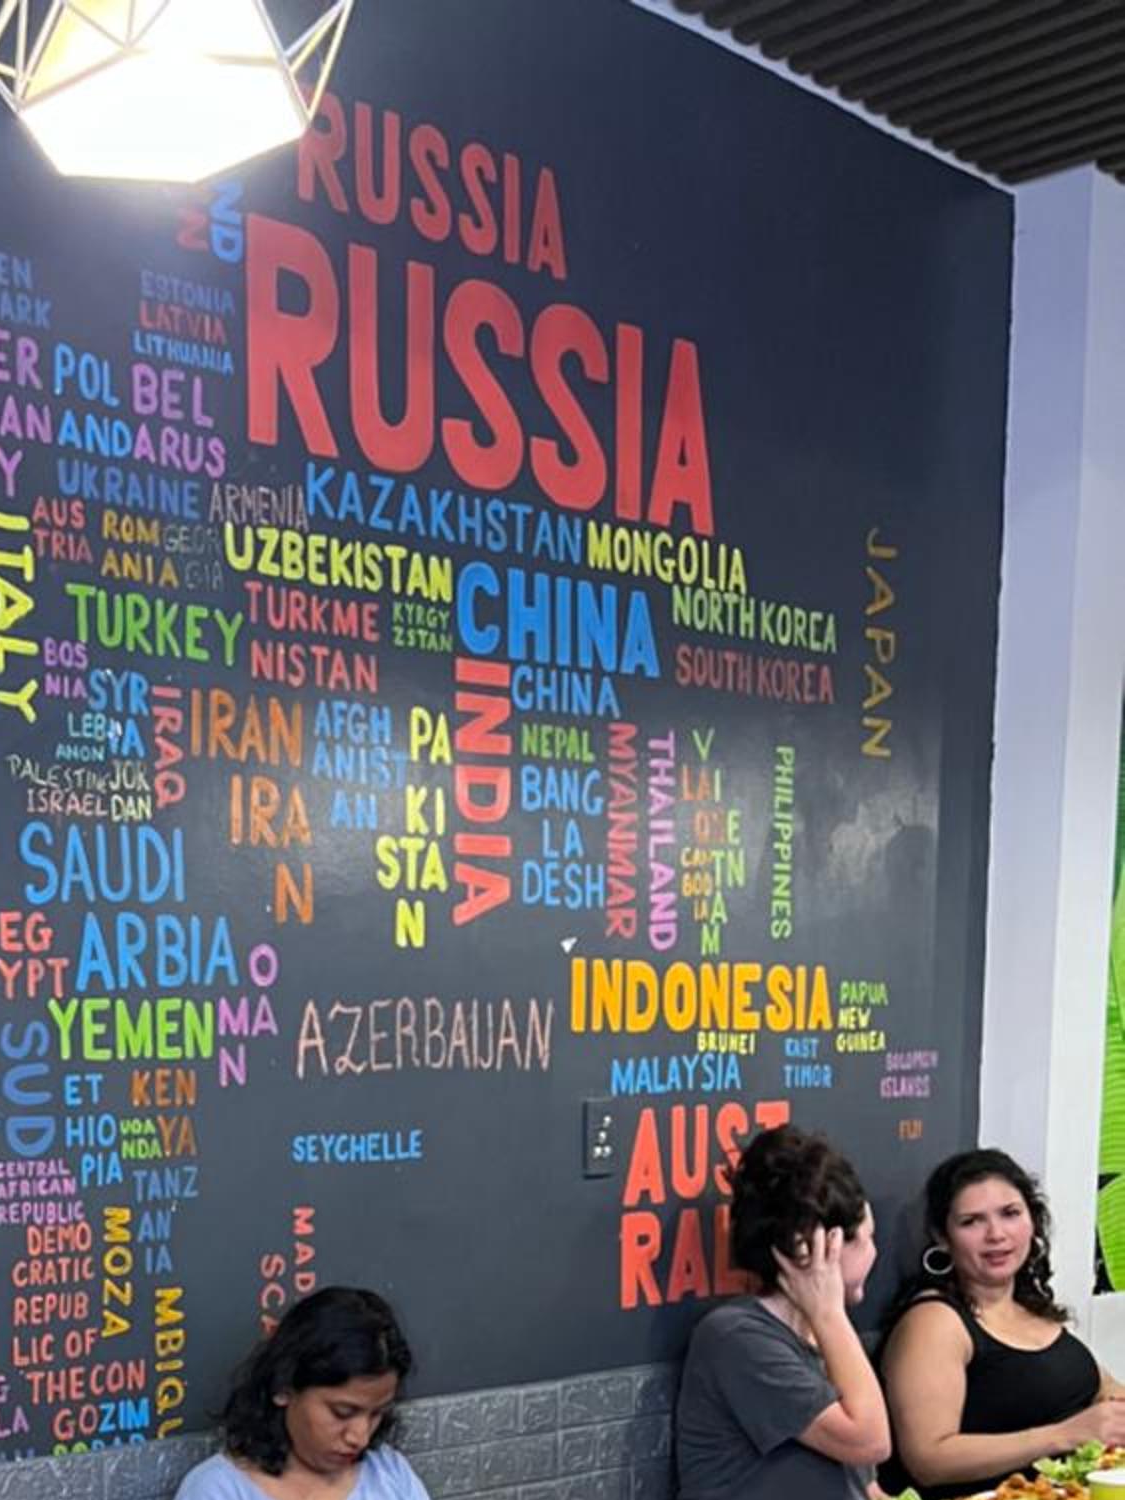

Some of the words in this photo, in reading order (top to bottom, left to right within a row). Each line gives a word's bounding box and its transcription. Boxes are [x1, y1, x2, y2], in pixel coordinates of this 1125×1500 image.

[296, 90, 567, 281] RUSSIA
[140, 269, 235, 314] ESTONIA
[138, 300, 227, 345] LATVIA
[53, 343, 119, 407] POL
[131, 362, 215, 429] BEL
[245, 212, 713, 536] RUSSIA
[58, 408, 132, 457] AND
[133, 422, 227, 479] ARUS
[32, 496, 87, 529] AUS
[57, 457, 201, 521] UKRAINE
[208, 480, 309, 533] ARMENIA
[305, 461, 581, 562] KAZAKHSTAN
[33, 528, 94, 564] TRIA
[101, 510, 160, 546] ROM
[101, 549, 179, 589] ANIA
[224, 520, 454, 603] UZBEKISTAN
[587, 521, 747, 595] MONGOLIA
[65, 583, 245, 667] TURKEY
[243, 580, 382, 643] TURKME
[455, 560, 662, 680] CHINA
[672, 583, 755, 641] NORTH
[759, 602, 838, 654] KOREA
[43, 636, 89, 669] BOS
[250, 639, 379, 695] NISTAN
[860, 527, 898, 760] JAPAN
[43, 673, 89, 700] NIA
[87, 667, 150, 717] SYR
[511, 664, 622, 719] CHINA
[675, 643, 754, 697] SOUTH
[757, 655, 836, 706] KOREA
[150, 684, 188, 811] IRAQ
[189, 686, 305, 768] IRAN
[313, 700, 393, 744] AFGH
[410, 705, 453, 765] PA
[521, 723, 595, 763] NEPAL
[312, 740, 408, 789] ANIST
[520, 764, 605, 816] BANG
[26, 789, 108, 817] ISRAEL
[110, 793, 153, 823] DAN
[228, 773, 316, 849] IRA
[330, 790, 378, 831] AN
[406, 784, 446, 837] KI
[452, 657, 513, 928] INDIA
[542, 818, 584, 860] LA
[605, 722, 638, 939] MYANMAR
[647, 729, 679, 951] THAILAND
[770, 745, 795, 939] PHILIPPINES
[19, 820, 185, 905] SAUDI
[377, 834, 448, 893] STA
[522, 860, 605, 910] DESH
[275, 862, 316, 925] N
[75, 911, 239, 993] ARBIA
[570, 957, 833, 1033] INDONESIA
[839, 979, 889, 1006] PAPUA
[48, 998, 214, 1062] YEMEN
[296, 997, 555, 1080] AZERBAIJAN
[697, 1032, 755, 1056] BRUNEI
[835, 1030, 886, 1053] GUINEA
[1, 1019, 56, 1158] SUD
[64, 1073, 104, 1106] ET
[131, 1068, 197, 1108] KEN
[610, 1053, 742, 1096] MALAYSIA
[783, 1064, 832, 1089] TIMOR
[64, 1113, 117, 1148] HIO
[156, 1114, 197, 1158] YA
[293, 1129, 424, 1163] SEYCHELLE
[80, 1151, 124, 1188] PIA
[133, 1165, 200, 1203] TANZ
[26, 1221, 93, 1257] DEMO
[11, 1256, 96, 1289] CRATIC
[102, 1206, 134, 1338] MOZA
[12, 1291, 90, 1327] REPUB
[11, 1333, 55, 1368] LIC
[64, 1327, 99, 1359] OF
[26, 1367, 86, 1404] THE
[90, 1359, 146, 1396] CON
[52, 1404, 100, 1441] GO
[98, 1396, 150, 1434] ZIM
